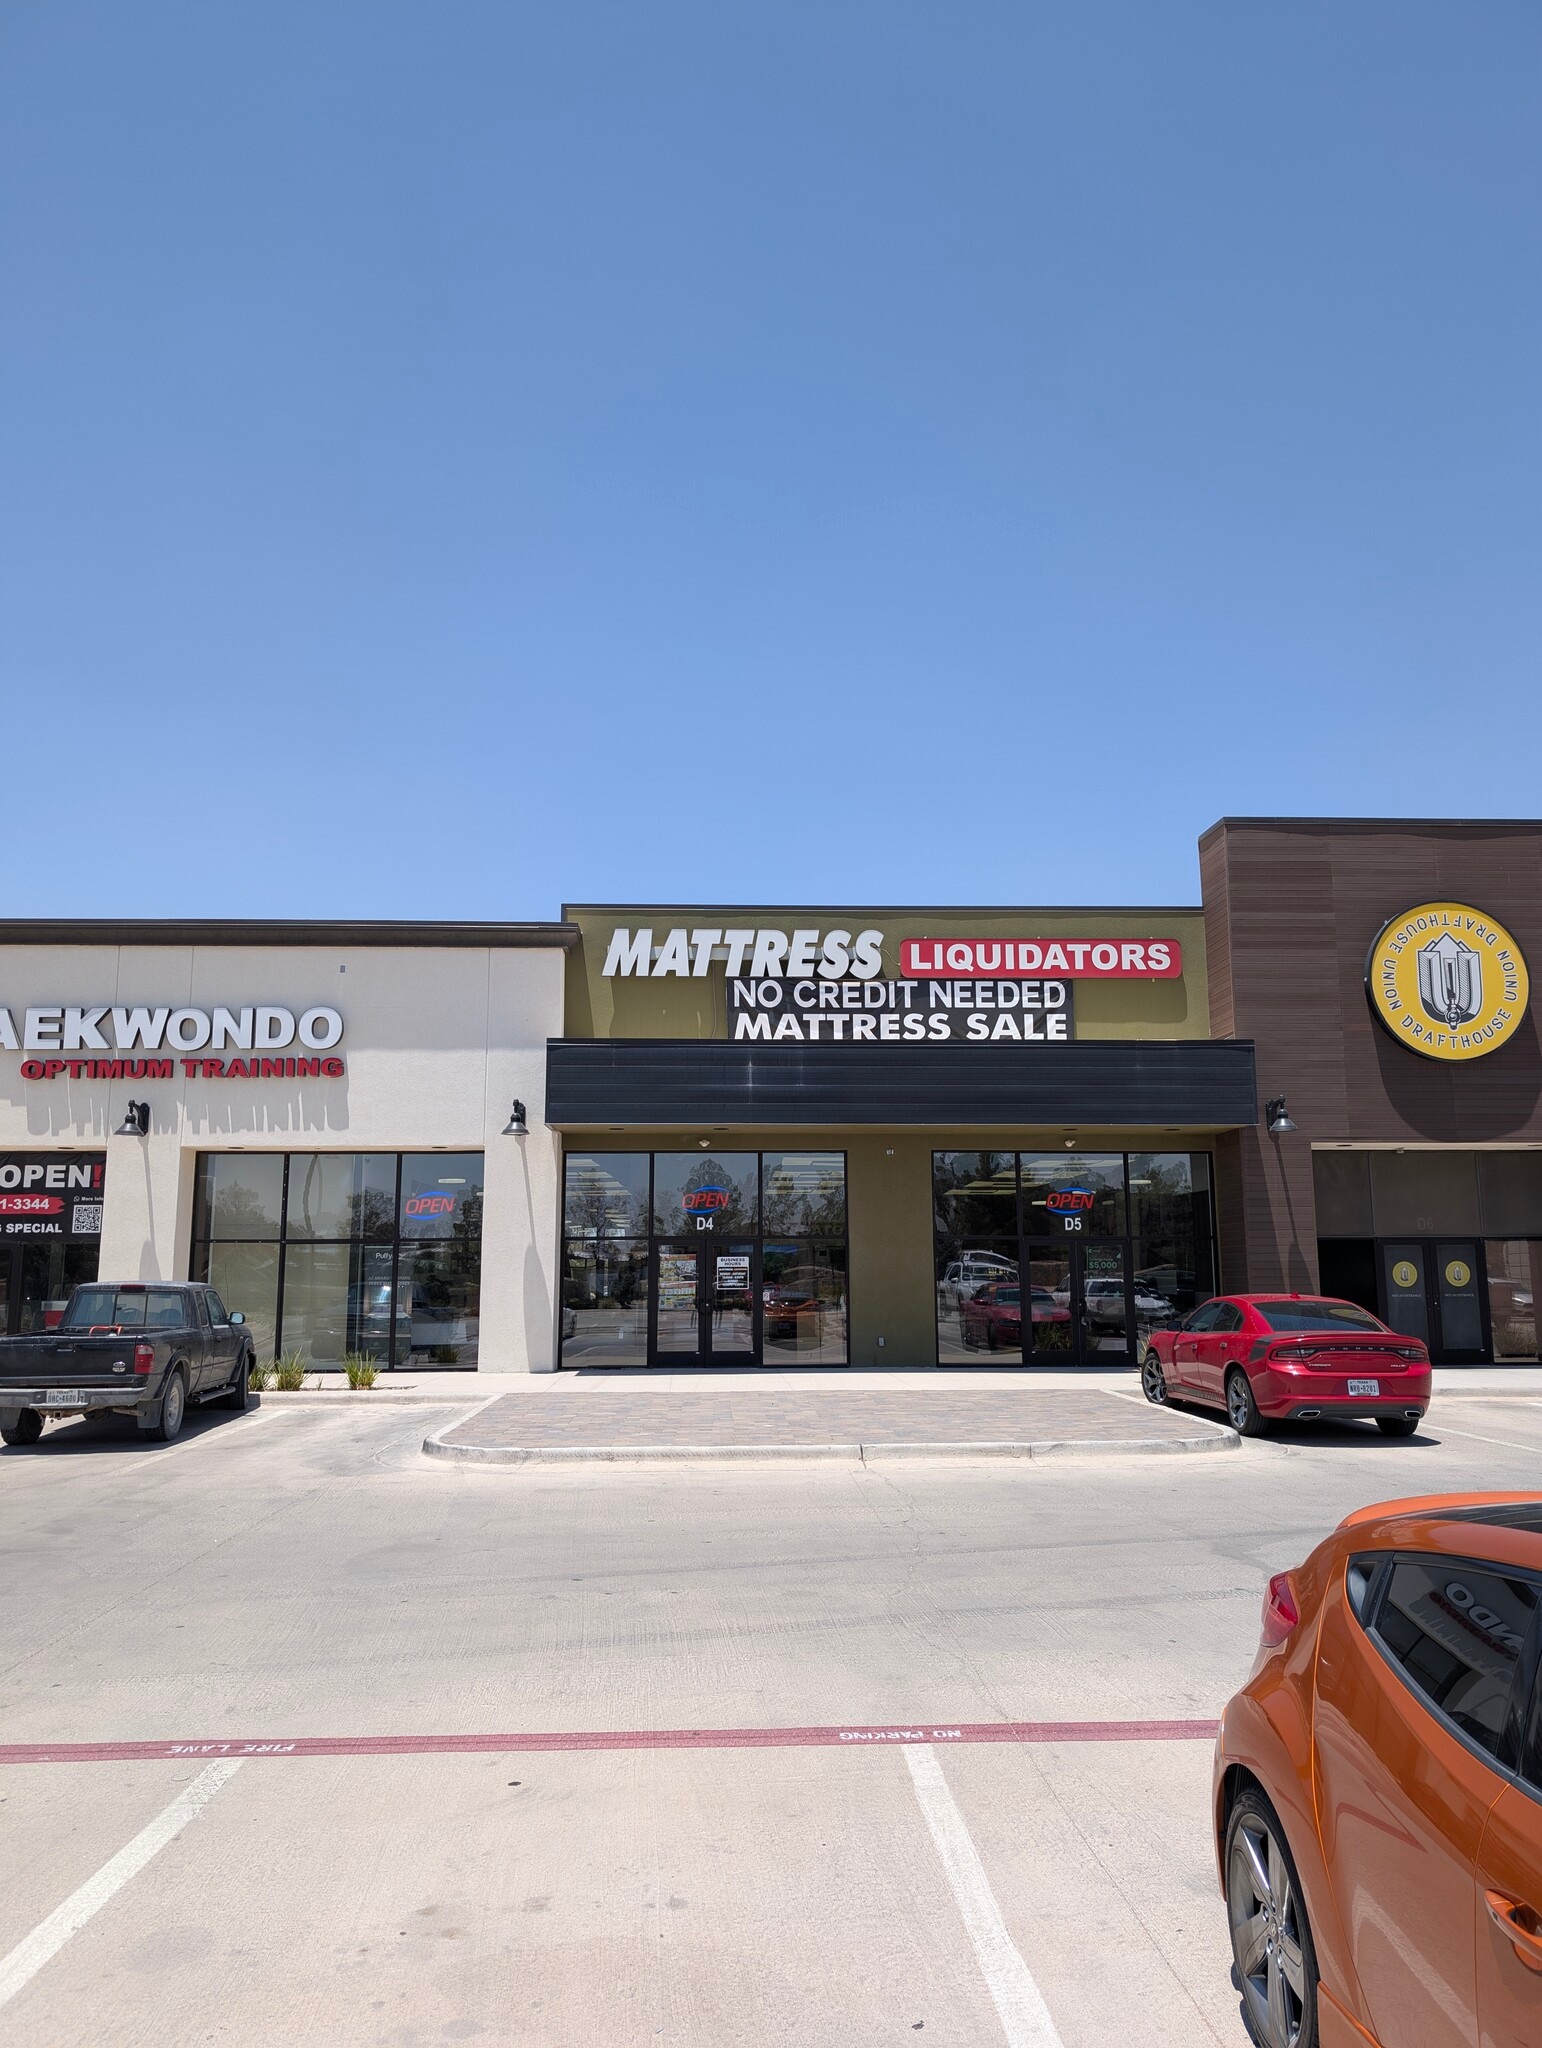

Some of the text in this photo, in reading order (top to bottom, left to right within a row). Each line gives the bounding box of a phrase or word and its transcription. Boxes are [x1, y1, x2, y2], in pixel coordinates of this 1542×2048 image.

[1389, 913, 1498, 954] DRAFTHOUSE
[602, 928, 1171, 979] MATTRESS LIQUIDATORS
[733, 980, 1066, 1008] NO CREDIT NEEDED
[1382, 949, 1518, 1049] UNION DRAFTHOUSE UNION
[734, 1013, 1067, 1040] MATTRESS SALE
[20, 1057, 345, 1080] OPTIMUM TRAINING
[0, 1164, 102, 1188] OPEN!
[405, 1197, 455, 1214] OPEN
[682, 1192, 729, 1208] OPEN
[1047, 1193, 1094, 1209] OPEN
[6, 1223, 62, 1233] SPECIAL
[696, 1217, 714, 1230] D4
[1064, 1217, 1082, 1231] D5
[1417, 1217, 1434, 1230] D6
[1088, 1261, 1117, 1269] $5,000
[839, 1730, 961, 1740] NO PARKING
[164, 1743, 296, 1754] FIRE LANE
